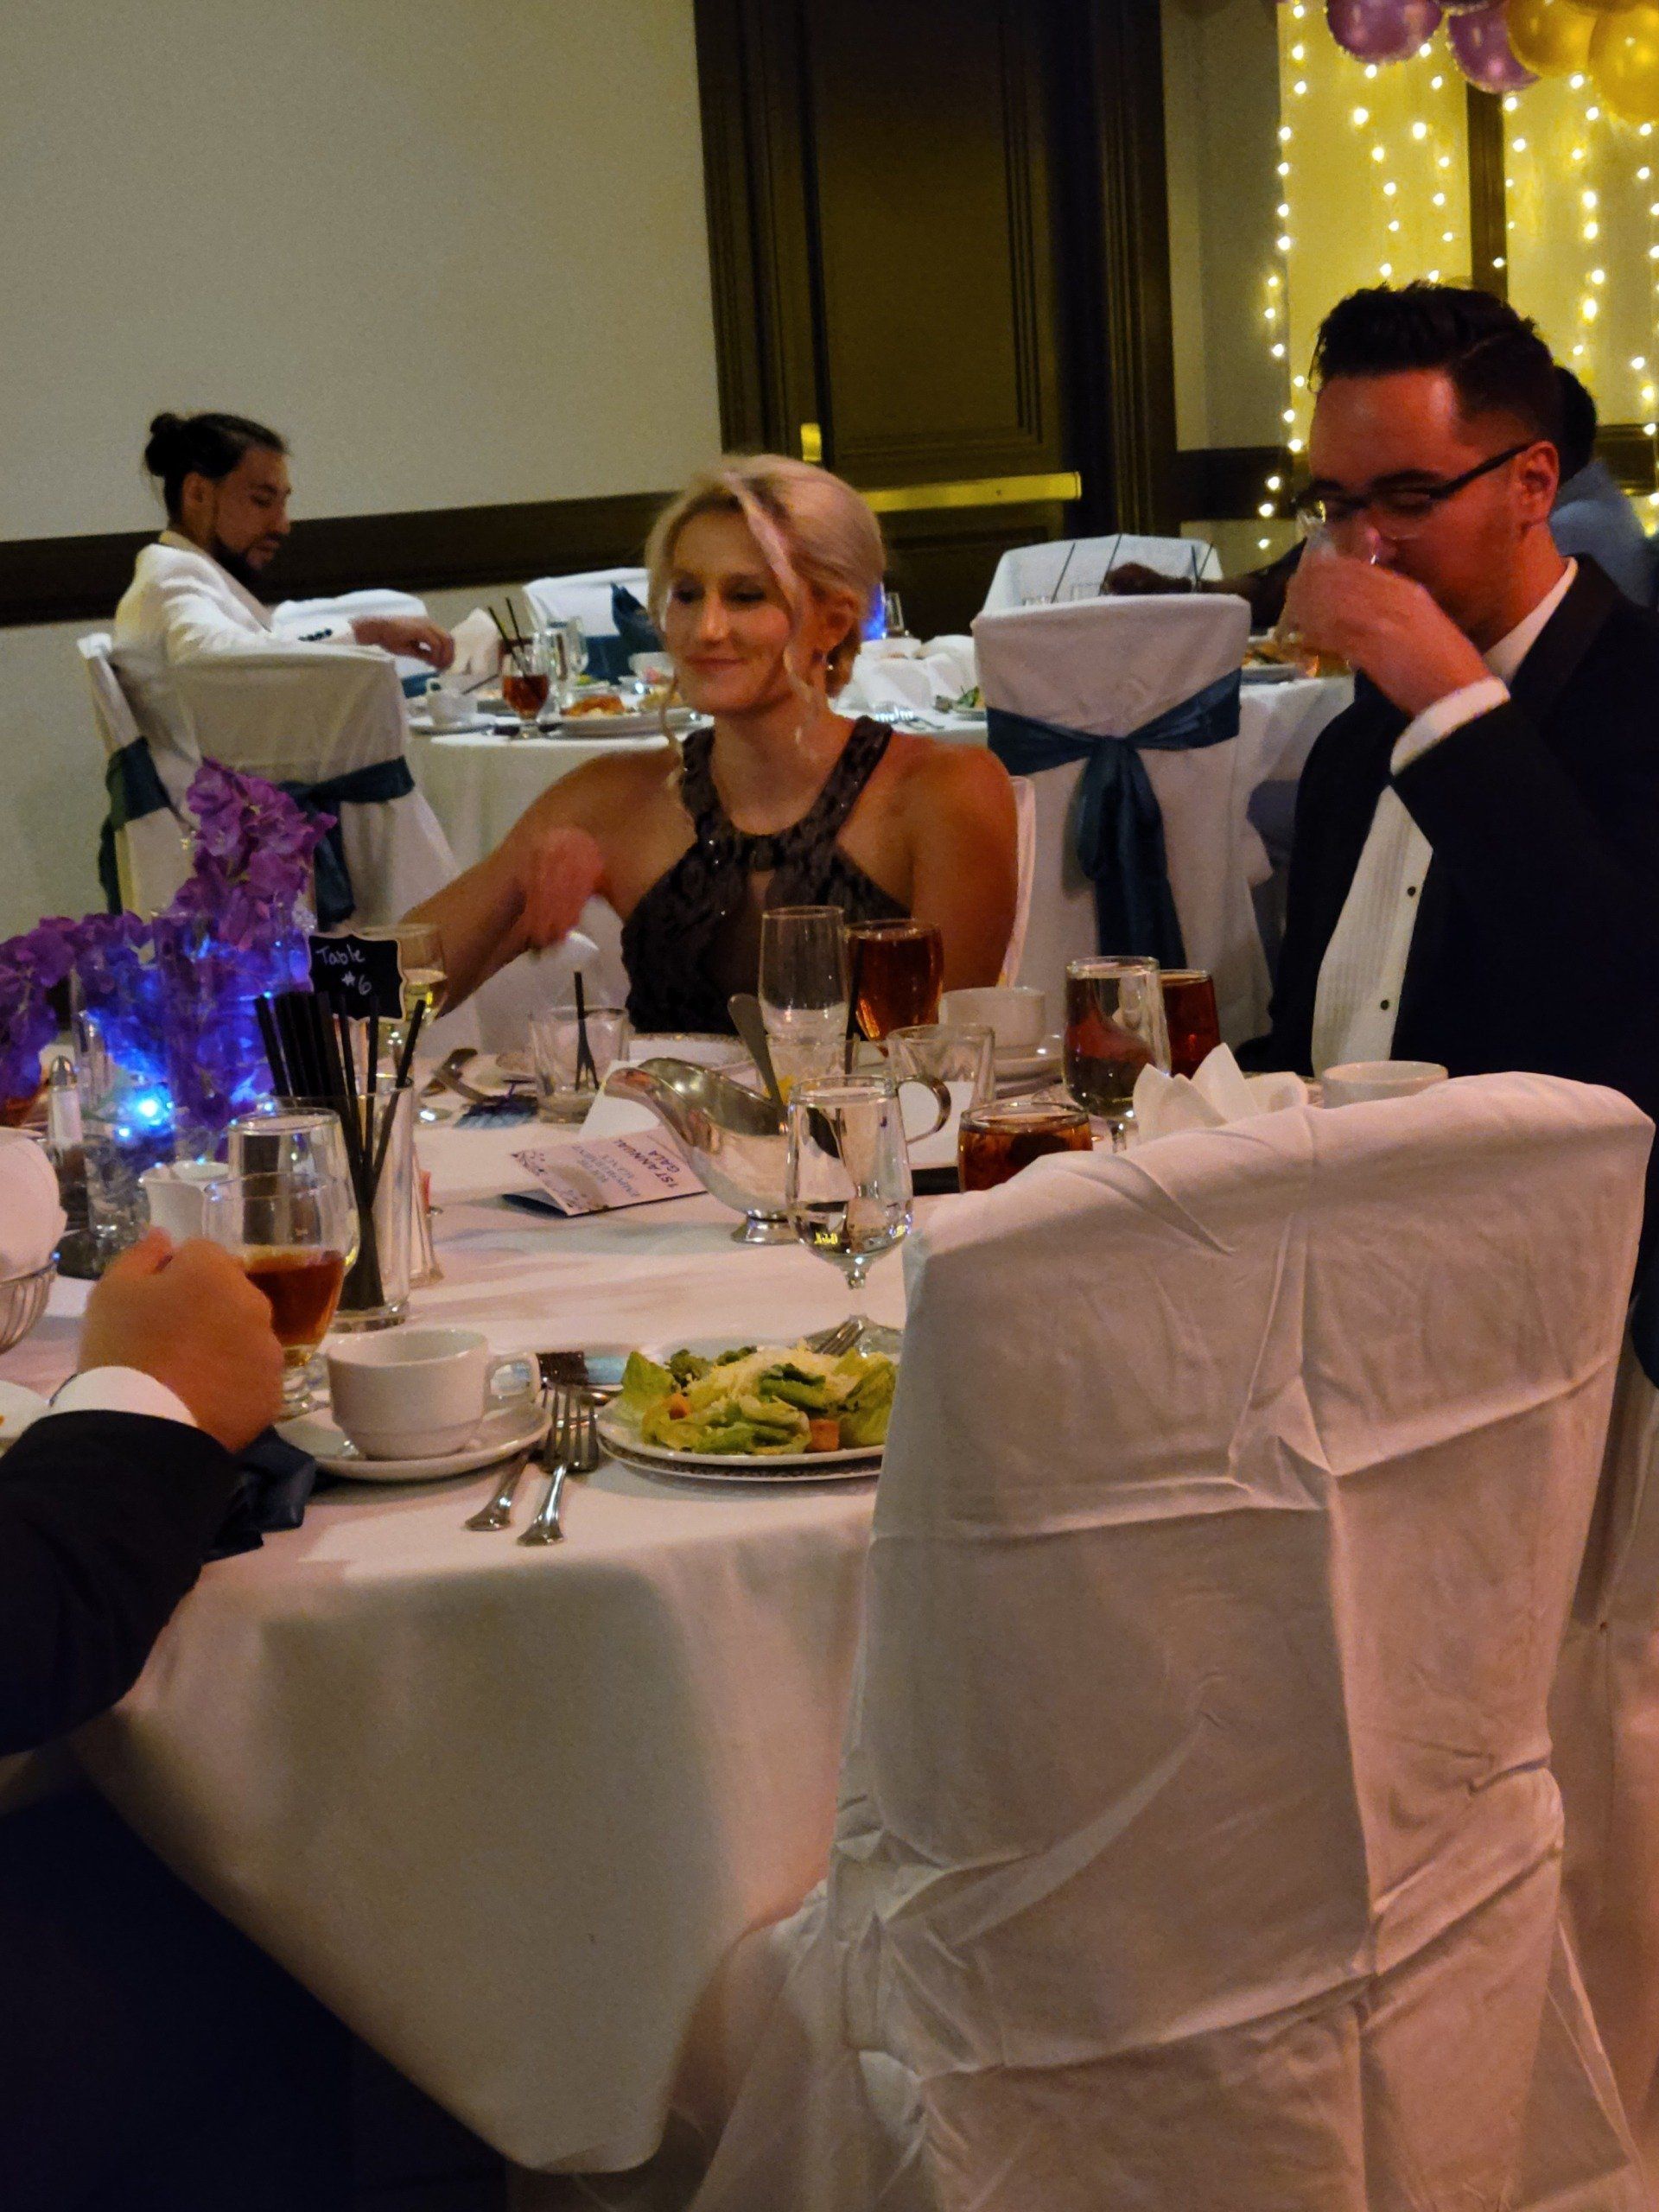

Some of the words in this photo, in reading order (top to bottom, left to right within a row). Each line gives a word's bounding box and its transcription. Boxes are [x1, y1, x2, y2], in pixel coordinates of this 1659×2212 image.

[315, 944, 366, 966] Table
[614, 1139, 658, 1173] ANNUAL
[648, 1149, 680, 1173] GALA
[654, 1172, 679, 1189] 1ST
